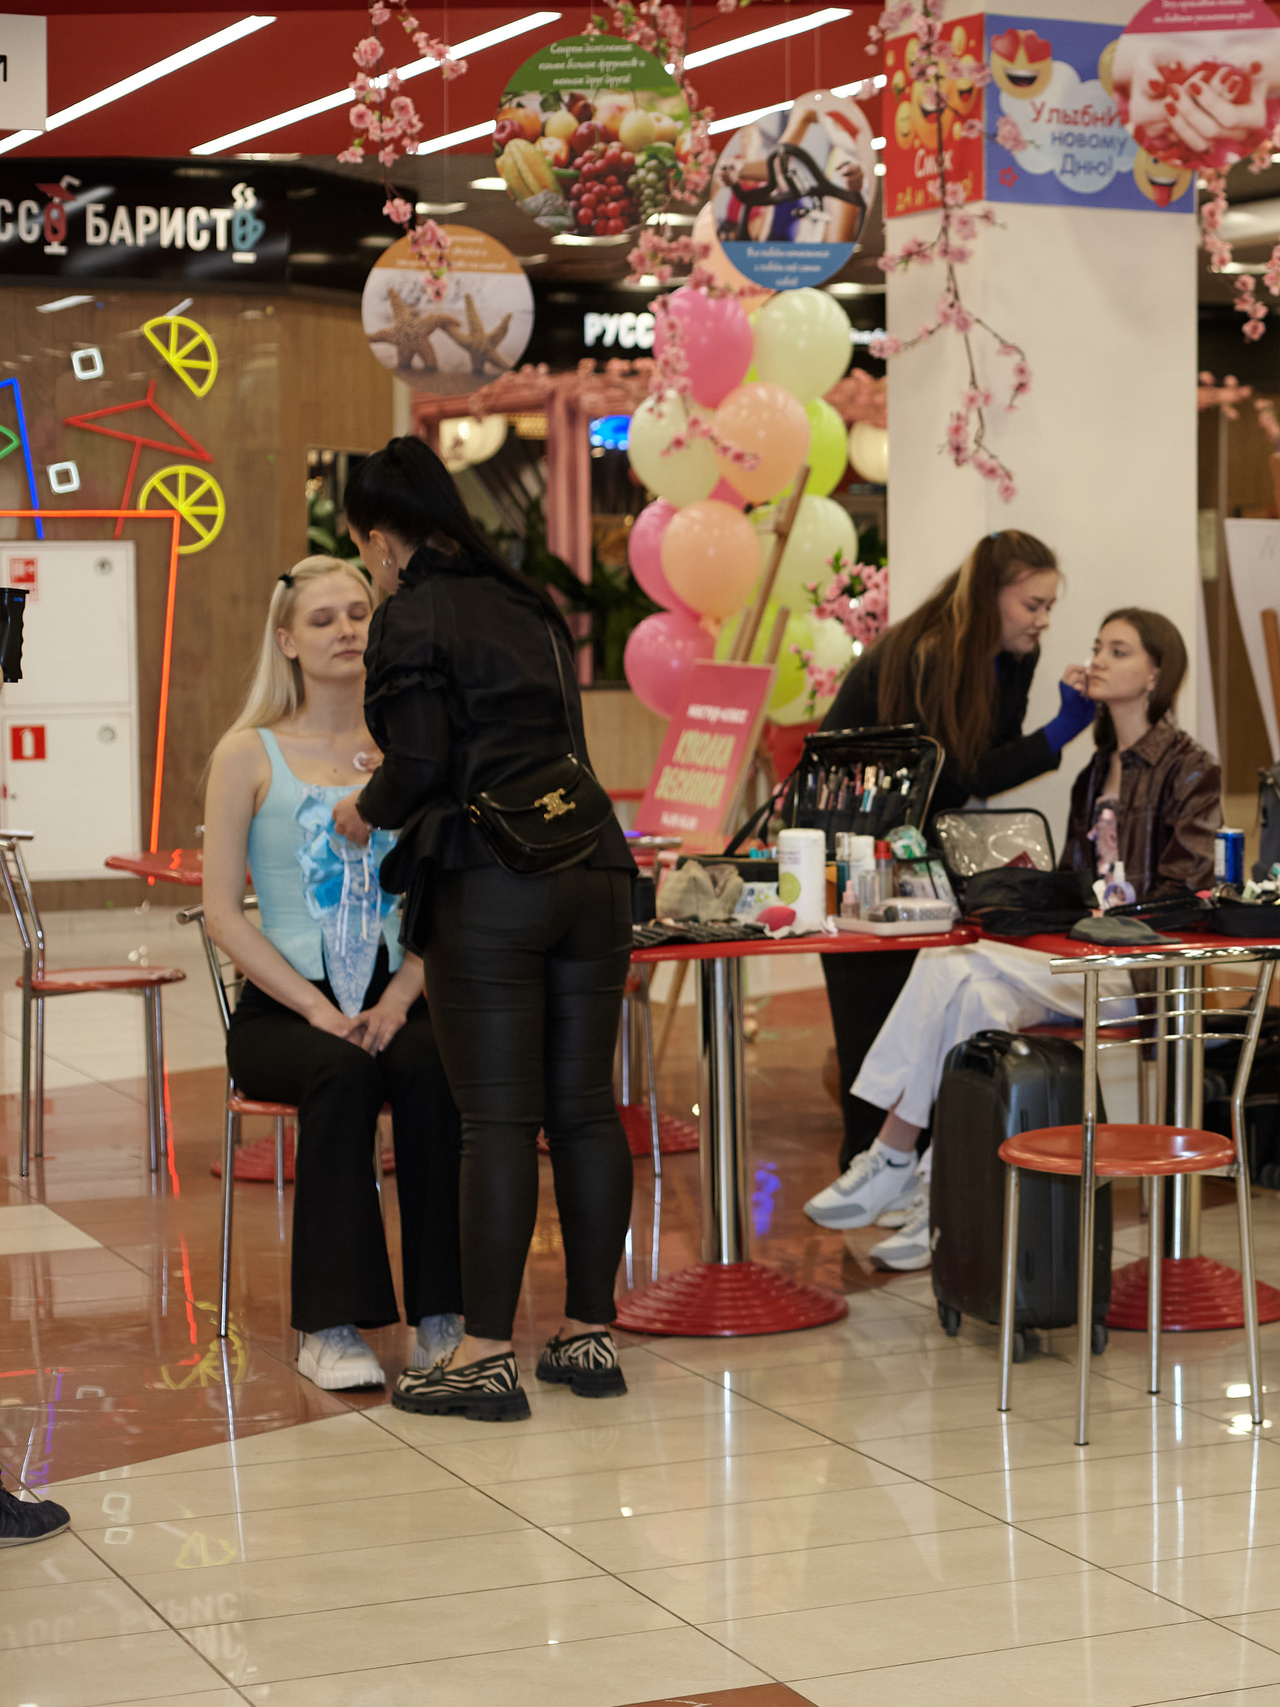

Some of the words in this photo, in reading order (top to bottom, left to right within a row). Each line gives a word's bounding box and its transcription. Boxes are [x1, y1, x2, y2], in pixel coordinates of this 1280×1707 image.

[1029, 100, 1123, 128] Улыбни
[1051, 131, 1127, 156] новому
[584, 312, 656, 349] РУСС
